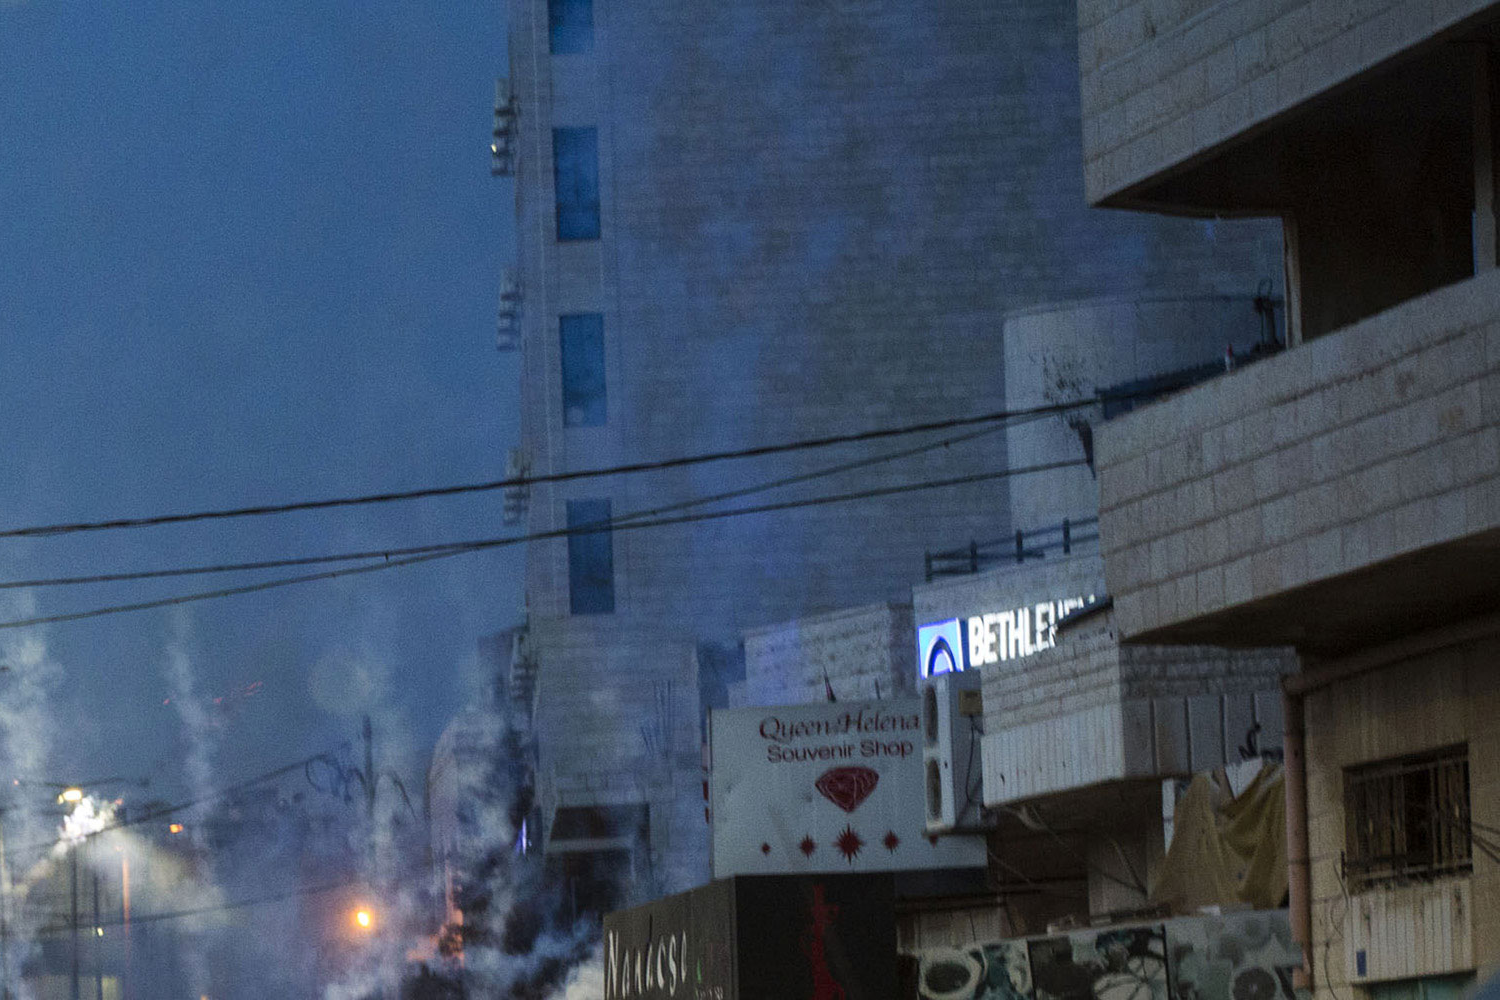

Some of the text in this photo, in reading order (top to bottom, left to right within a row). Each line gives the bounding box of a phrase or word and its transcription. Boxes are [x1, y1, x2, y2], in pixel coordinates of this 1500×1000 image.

[967, 594, 1095, 668] BETHLEH
[759, 707, 920, 743] Queen Helena
[767, 738, 914, 763] Souvenir Shop
